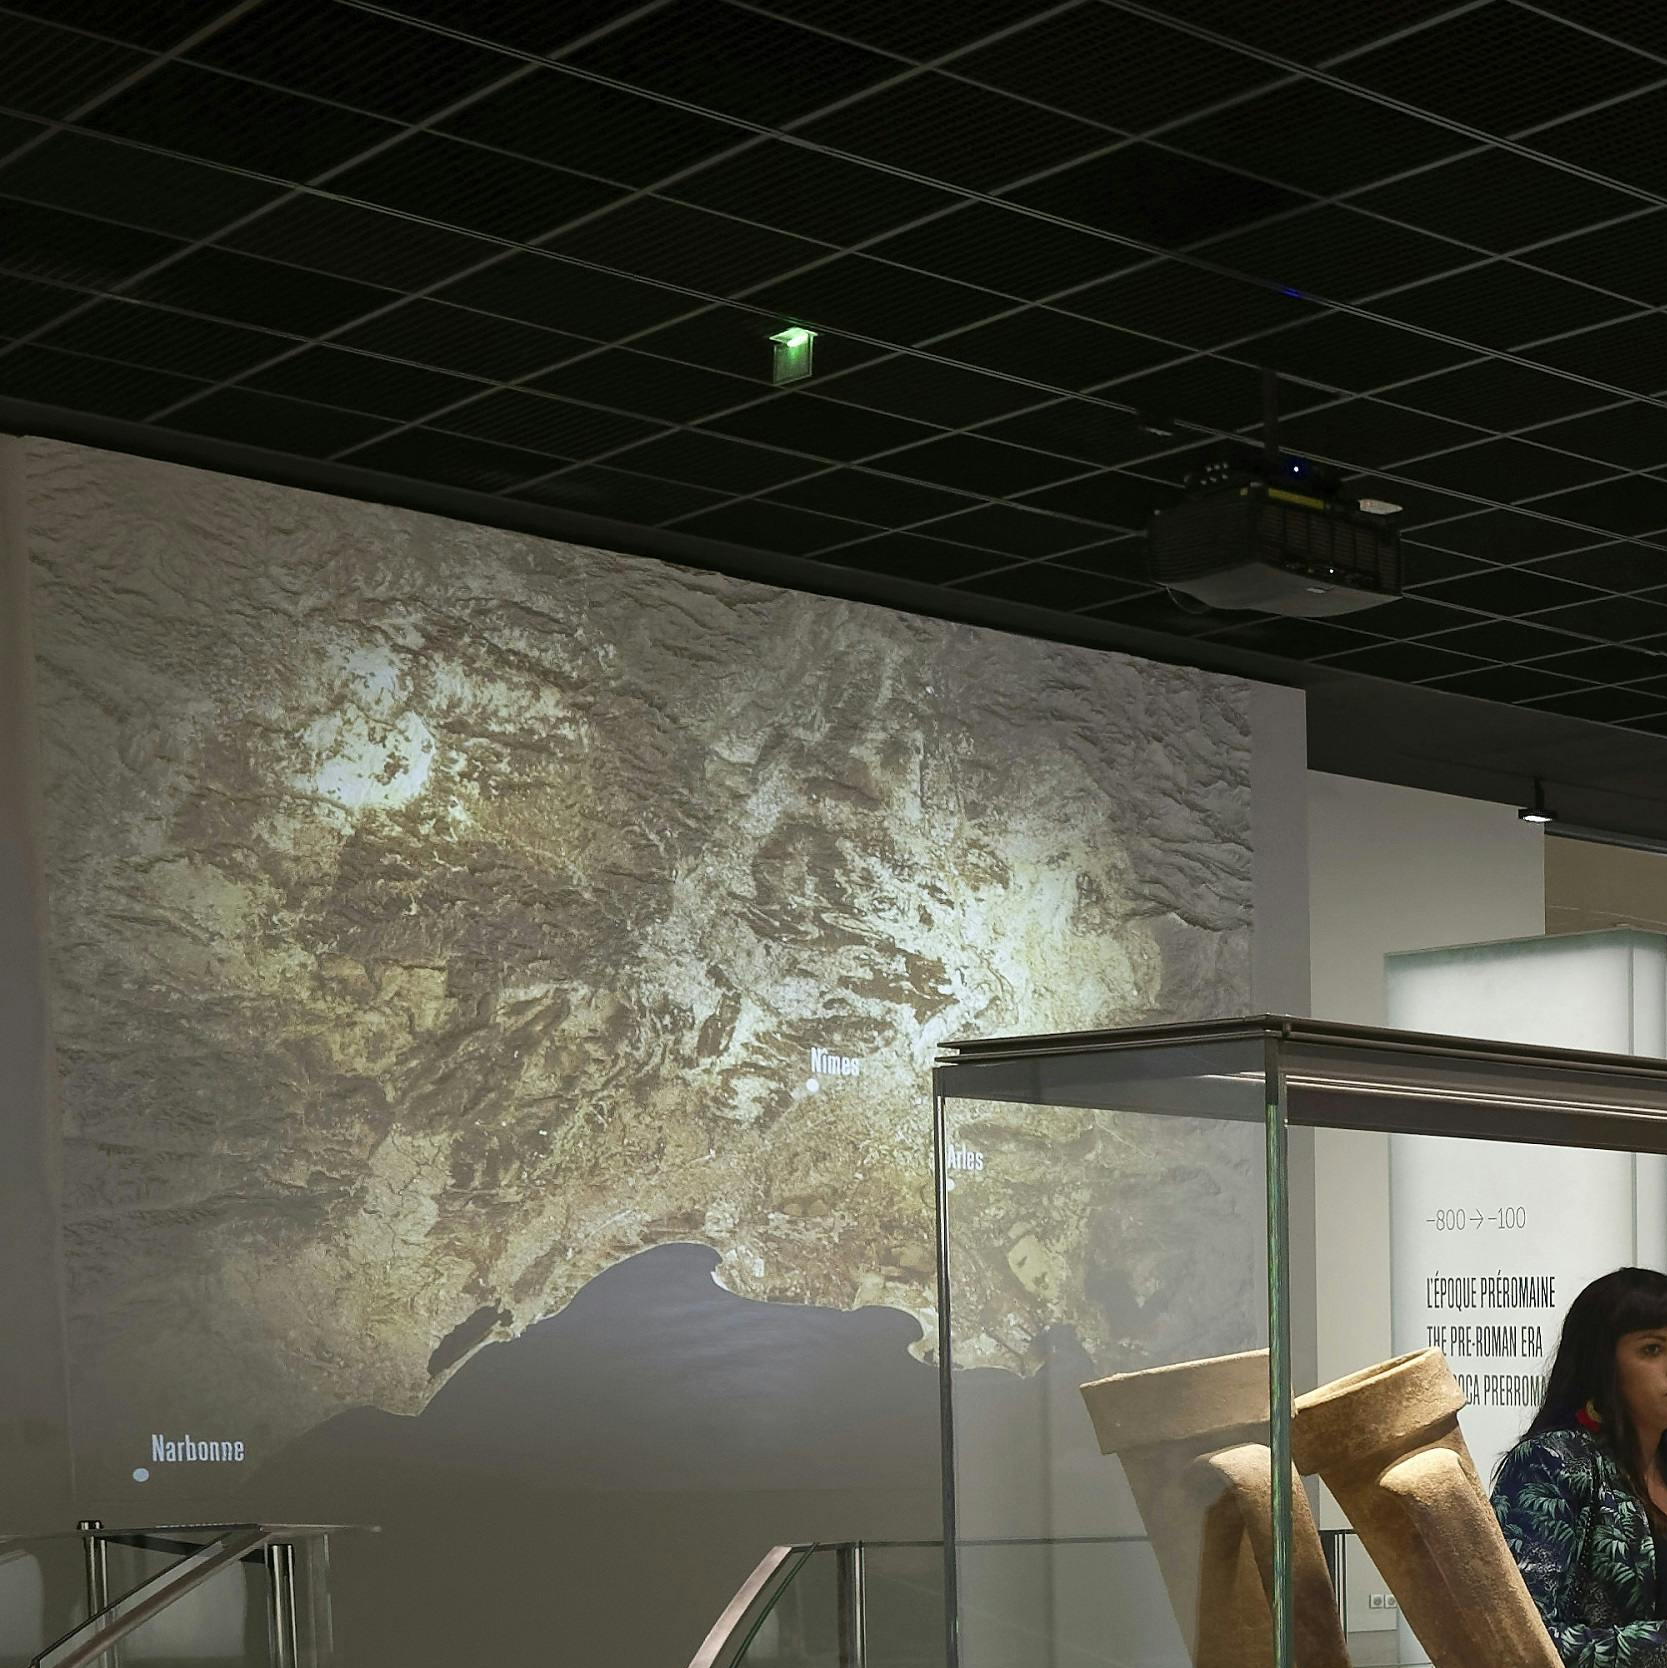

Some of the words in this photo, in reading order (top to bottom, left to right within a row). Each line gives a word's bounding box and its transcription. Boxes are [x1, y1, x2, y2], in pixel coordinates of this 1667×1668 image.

[810, 1047, 860, 1076] Nîmes
[946, 1144, 984, 1171] Arles
[1426, 1270, 1477, 1311] L'ÉPOQUE
[1480, 1269, 1556, 1309] PRÉROMAINE
[1426, 1326, 1447, 1357] THE
[1450, 1325, 1517, 1358] PRE-ROMAN
[1521, 1325, 1543, 1358] ERA
[1453, 1373, 1480, 1406] OCA
[152, 1434, 245, 1462] Narbonne
